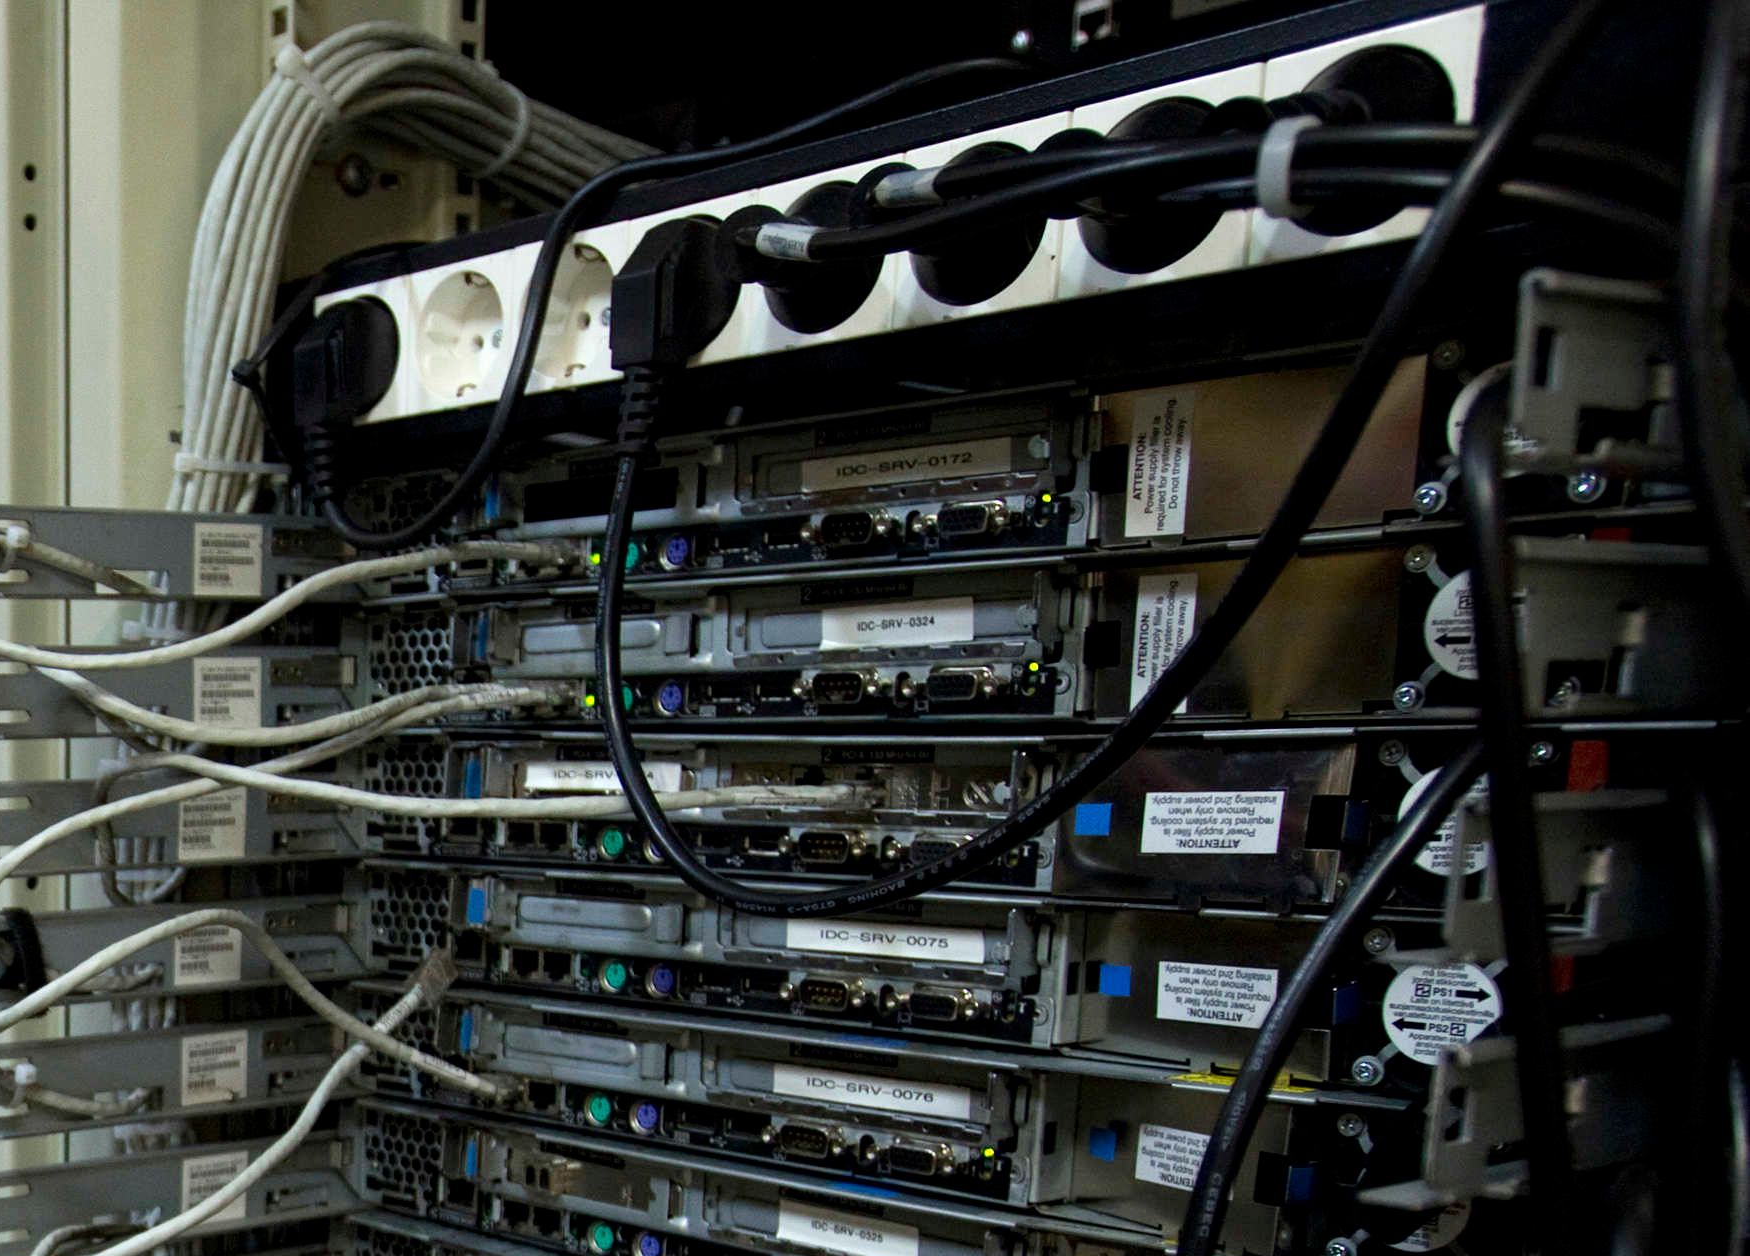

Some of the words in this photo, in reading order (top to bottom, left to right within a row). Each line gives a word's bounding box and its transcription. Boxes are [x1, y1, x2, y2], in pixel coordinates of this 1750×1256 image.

[1160, 438, 1171, 473] system
[1171, 447, 1181, 474] throw
[836, 452, 973, 476] IDC-SRV-0172
[1132, 432, 1146, 499] ATTENTION:
[1148, 448, 1158, 480] supply
[1158, 476, 1167, 488] for
[1170, 476, 1179, 492] not
[1144, 483, 1154, 513] Power
[1169, 495, 1178, 508] Do
[1155, 491, 1167, 530] required
[1155, 596, 1163, 604] is
[1153, 607, 1161, 625] filler
[856, 615, 934, 632] IDC-SRV-0324
[1163, 618, 1174, 652] system
[1136, 611, 1149, 677] ATTENTION:
[1151, 628, 1161, 659] supply
[1184, 796, 1211, 804] power
[1234, 794, 1276, 804] installing
[1195, 806, 1213, 815] only
[1216, 807, 1254, 815] Remove
[1185, 816, 1217, 824] system
[1235, 816, 1274, 824] required
[1162, 828, 1170, 836] is
[1193, 827, 1223, 836] supply
[1226, 828, 1255, 836] Power
[1175, 839, 1240, 847] ATTENTION:
[819, 929, 948, 948] IDC-SRV-0075
[1192, 967, 1216, 976] power
[1218, 970, 1233, 979] 2nd
[1236, 970, 1271, 982] installing
[1178, 977, 1199, 985] when
[1202, 977, 1218, 988] only
[1220, 980, 1253, 991] Remove
[1194, 987, 1221, 997] system
[1224, 991, 1234, 999] for
[1237, 991, 1270, 1002] required
[1433, 987, 1451, 996] PS1
[1175, 996, 1182, 1004] is
[1202, 998, 1227, 1009] supply
[1230, 1002, 1255, 1012] Power
[1186, 1007, 1242, 1021] ATTENTION:
[1429, 1023, 1448, 1032] PS2
[806, 1077, 934, 1103] IDC-SRV-0076
[811, 1220, 883, 1243] IDC-SRV-0325
